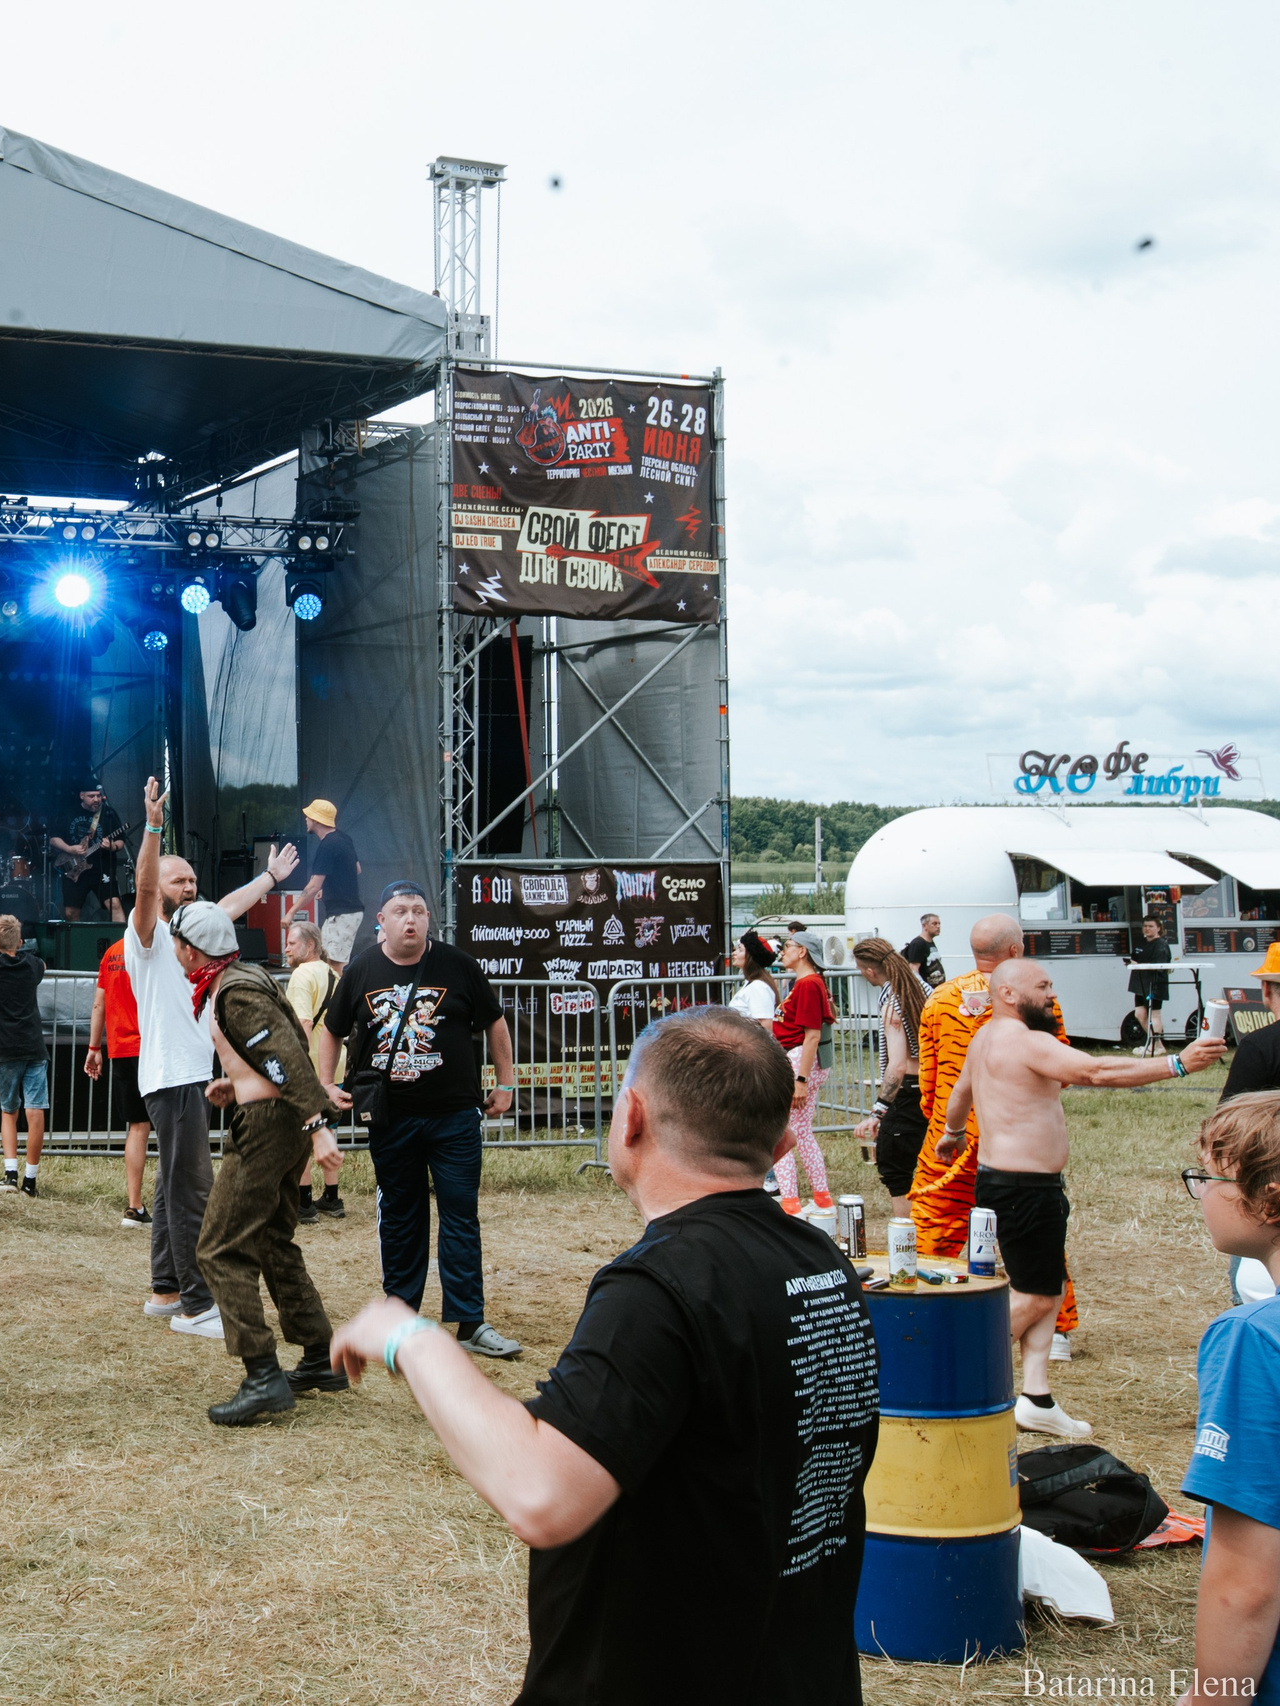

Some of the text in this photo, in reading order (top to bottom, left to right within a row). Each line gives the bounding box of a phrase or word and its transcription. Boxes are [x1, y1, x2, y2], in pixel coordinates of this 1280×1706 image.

[578, 397, 613, 419] 2026
[646, 396, 707, 435] 26-28
[565, 420, 616, 444] ANTI-
[568, 442, 611, 461] PARTY
[643, 427, 701, 464] ИЮНЯ
[641, 456, 669, 471] ТВЕРСКАЯ
[545, 467, 581, 480] ТЕРРИТОРИЯ
[608, 464, 633, 476] МУЗЫКИ
[639, 466, 696, 488] ЛЕСНОЙ СКИТ
[453, 483, 468, 498] ДВЕ
[454, 515, 463, 525] DJ
[464, 516, 486, 527] SASHA
[526, 512, 641, 551] СВОЙ ФЕСТ
[455, 535, 465, 546] DJ
[480, 536, 496, 547] TRUE
[519, 552, 558, 585] ДЛЯ
[648, 559, 687, 571] АЛЕКСАНДР
[1125, 764, 1221, 805] либри
[523, 879, 564, 891] СВОБОДА
[524, 891, 546, 901] ВАЖНЕЕ
[668, 888, 699, 902] CATS
[555, 917, 594, 933] УГАРНЫЙ
[523, 928, 550, 939] 3000
[476, 958, 523, 975] ОФИГУ
[560, 958, 582, 973] PUNK
[649, 961, 714, 978] МАНЕКЕНЫ
